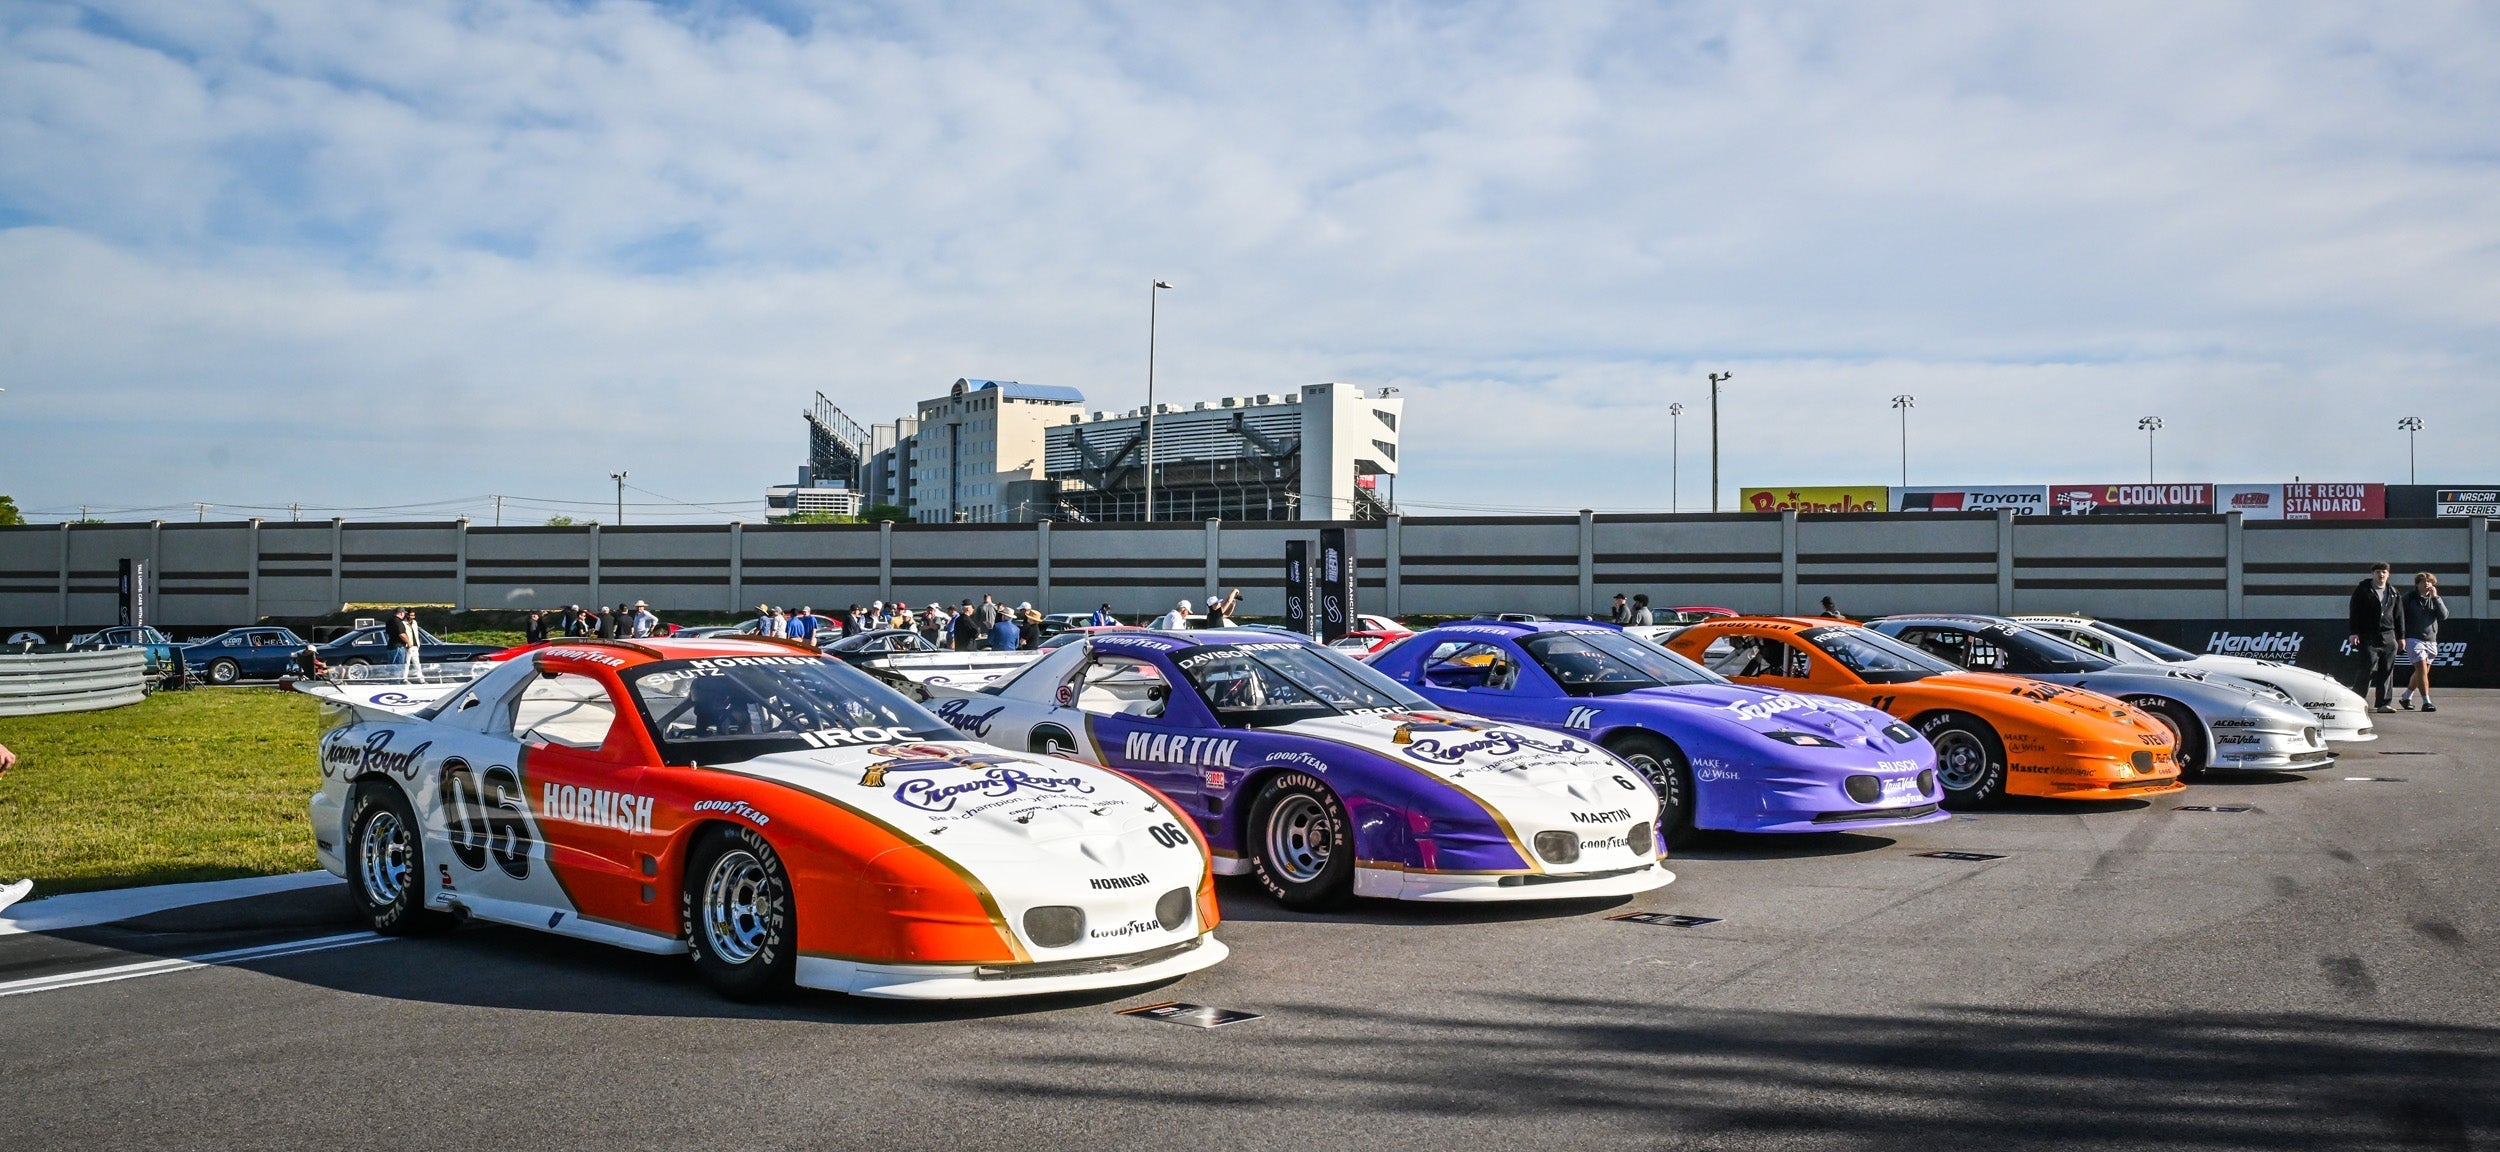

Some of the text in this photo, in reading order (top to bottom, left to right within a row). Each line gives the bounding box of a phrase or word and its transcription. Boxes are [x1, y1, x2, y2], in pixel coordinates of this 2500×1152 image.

[1970, 493, 2041, 503] TOYOTA
[2119, 486, 2168, 505] COOK
[2286, 485, 2365, 498] THE RECON
[2459, 492, 2497, 502] NASCAR
[2287, 499, 2366, 512] STANDARD.
[2446, 505, 2497, 514] CUP SERIES
[1309, 603, 1314, 614] OF
[1707, 621, 1791, 631] GOODYEAR
[1097, 637, 1172, 651] GOODYEAR
[2206, 632, 2305, 655] Hendrick
[545, 649, 625, 667] GOODYEAR
[689, 656, 825, 669] HORNISH
[2223, 651, 2298, 660] PERFORMANCE
[646, 668, 726, 687] SLUTZ
[1870, 695, 1896, 712] 11
[1563, 705, 1605, 730] 1K
[2213, 720, 2256, 728] ACDelco
[799, 726, 926, 749] IROC
[321, 724, 433, 784] Crown Royal
[1125, 731, 1239, 767] MARTIN
[1402, 738, 1500, 765] Crown
[1265, 751, 1329, 774] GOODYEAR
[1692, 758, 1720, 768] MAKE
[1877, 759, 1919, 772] BUSCH
[893, 768, 1096, 813] Crown Royal
[1613, 775, 1636, 791] 6
[1662, 757, 1679, 807] EAGLE
[1976, 762, 2000, 800] EAGLE
[543, 782, 655, 834] HORNISH
[693, 800, 770, 827] GOODYEAR
[1276, 774, 1343, 846] GOODYEAR
[1570, 807, 1631, 823] MARTIN
[438, 755, 534, 881] 06
[1147, 822, 1189, 849] 06
[1090, 872, 1150, 890] HORNISH
[1252, 855, 1286, 899] EAGLE
[740, 826, 784, 965] GOODYEAR
[683, 890, 701, 962] EAGLE
[1090, 920, 1160, 938] GOODYEAR
